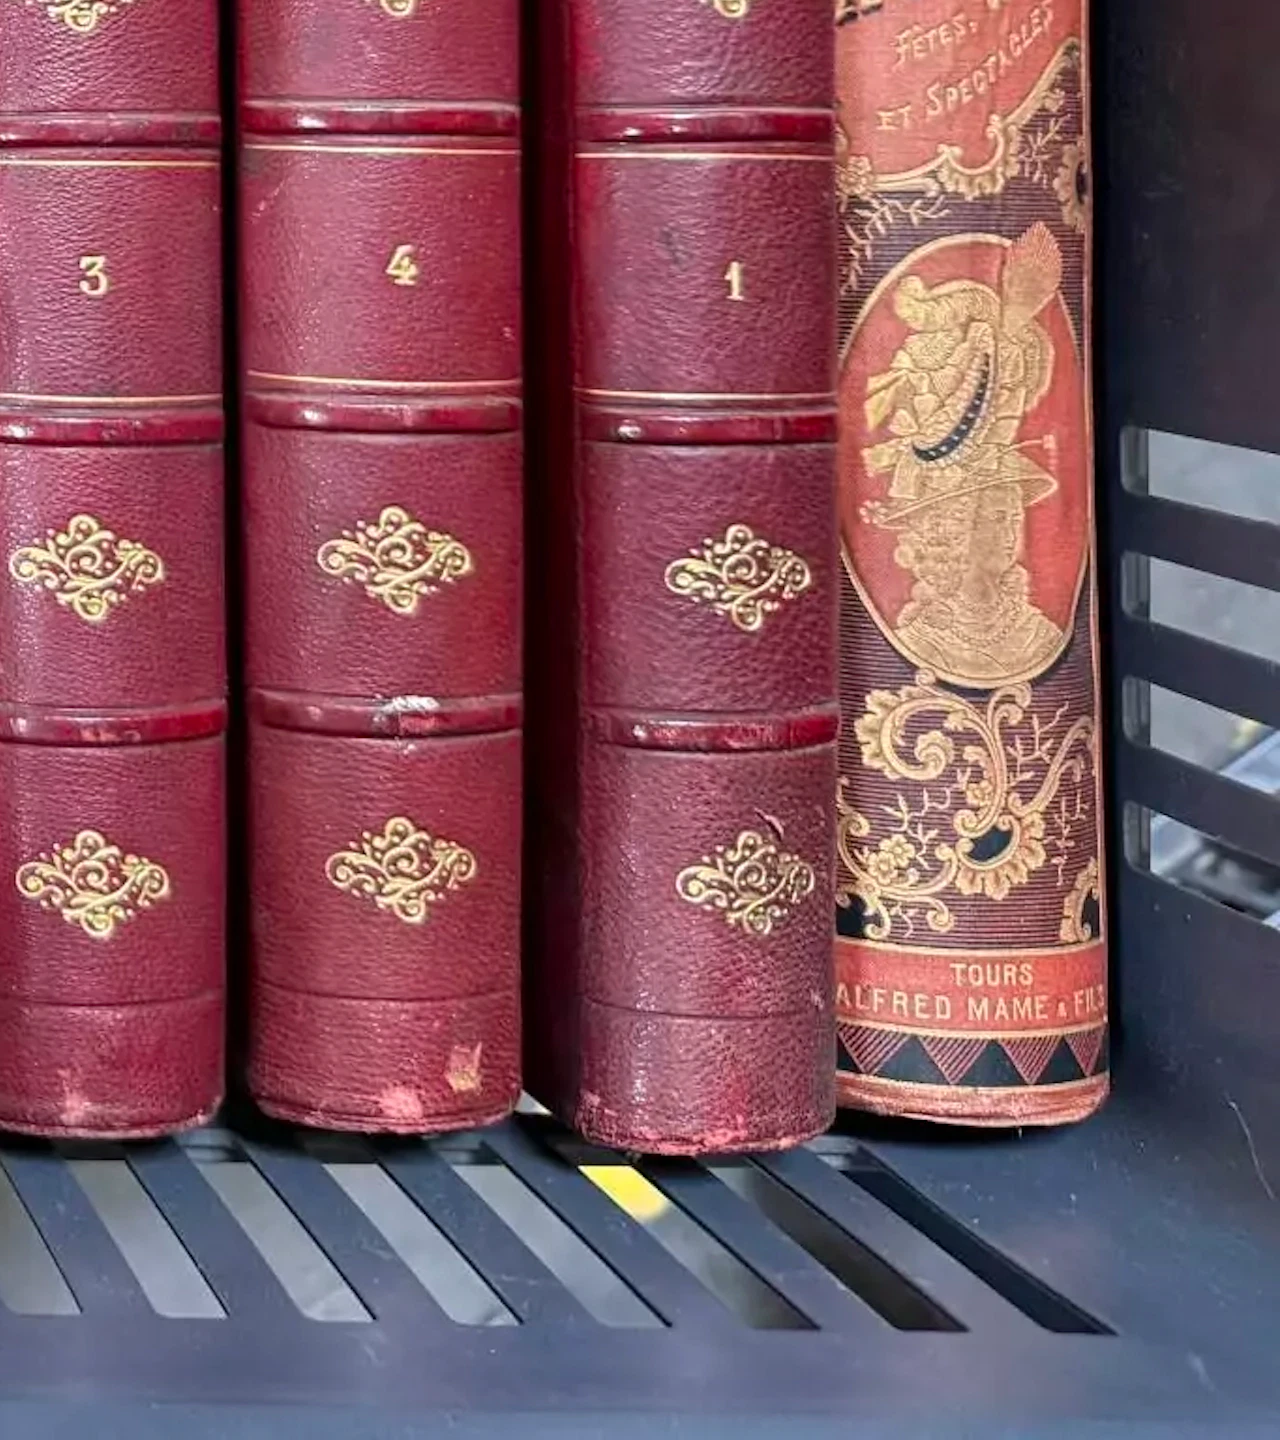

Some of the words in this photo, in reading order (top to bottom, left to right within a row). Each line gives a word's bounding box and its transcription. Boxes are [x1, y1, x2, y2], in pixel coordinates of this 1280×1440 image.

[876, 105, 911, 130] ET
[79, 255, 108, 297] 3
[386, 244, 419, 286] 4
[724, 261, 745, 301] 1
[949, 963, 1034, 987] TOURS
[835, 983, 952, 1020] ALFRED
[968, 995, 1049, 1021] MAME
[1073, 984, 1105, 1017] FILS
